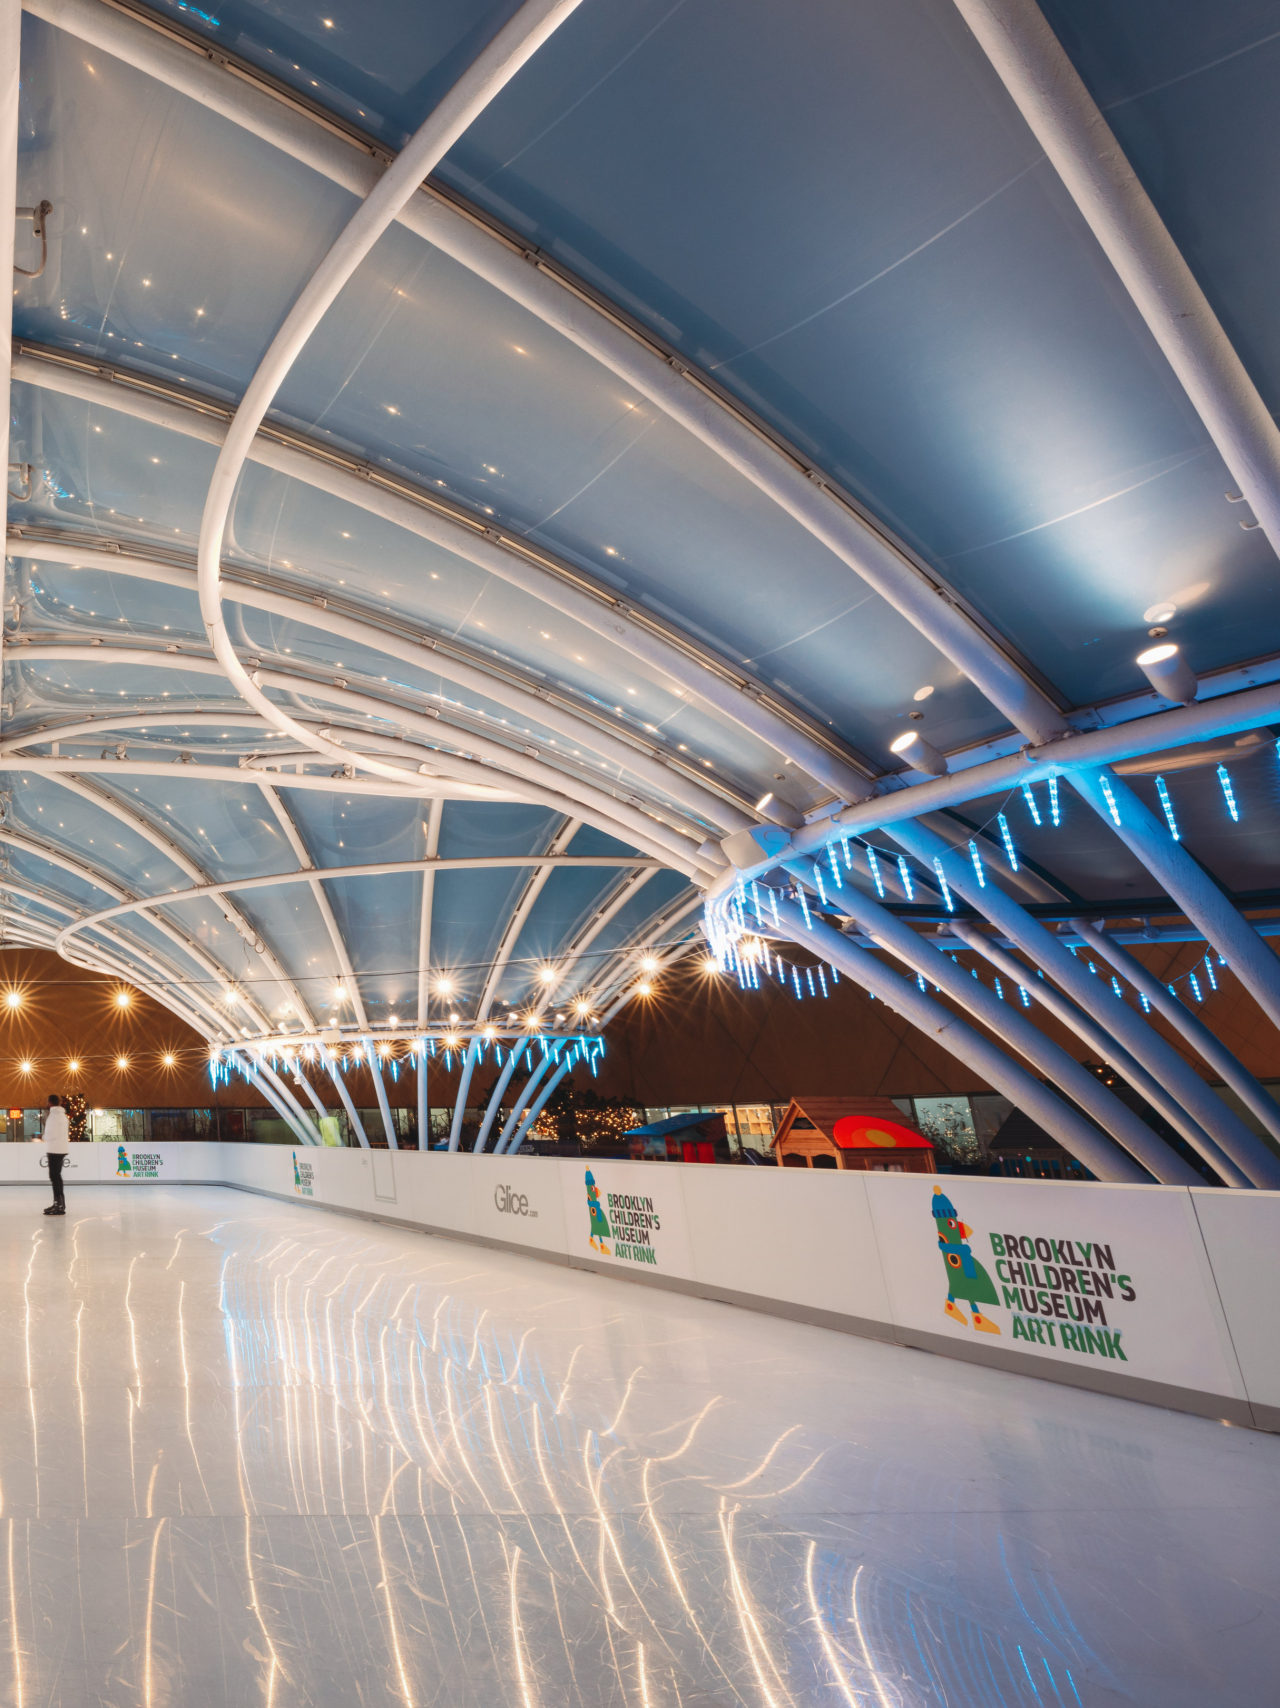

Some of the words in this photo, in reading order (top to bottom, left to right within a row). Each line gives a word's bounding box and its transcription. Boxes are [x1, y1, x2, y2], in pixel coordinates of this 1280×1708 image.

[607, 1193, 654, 1213] BROOKLYN
[609, 1209, 661, 1230] CHILDREN'S
[611, 1226, 650, 1246] MUSEUM
[615, 1243, 632, 1260] ART
[632, 1245, 657, 1265] RINK
[989, 1232, 1116, 1271] BROOKLYN
[995, 1259, 1137, 1302] CHILDREN'S
[1001, 1285, 1108, 1327] MUSEUM
[1012, 1313, 1057, 1347] ART
[1058, 1320, 1129, 1362] RINK
